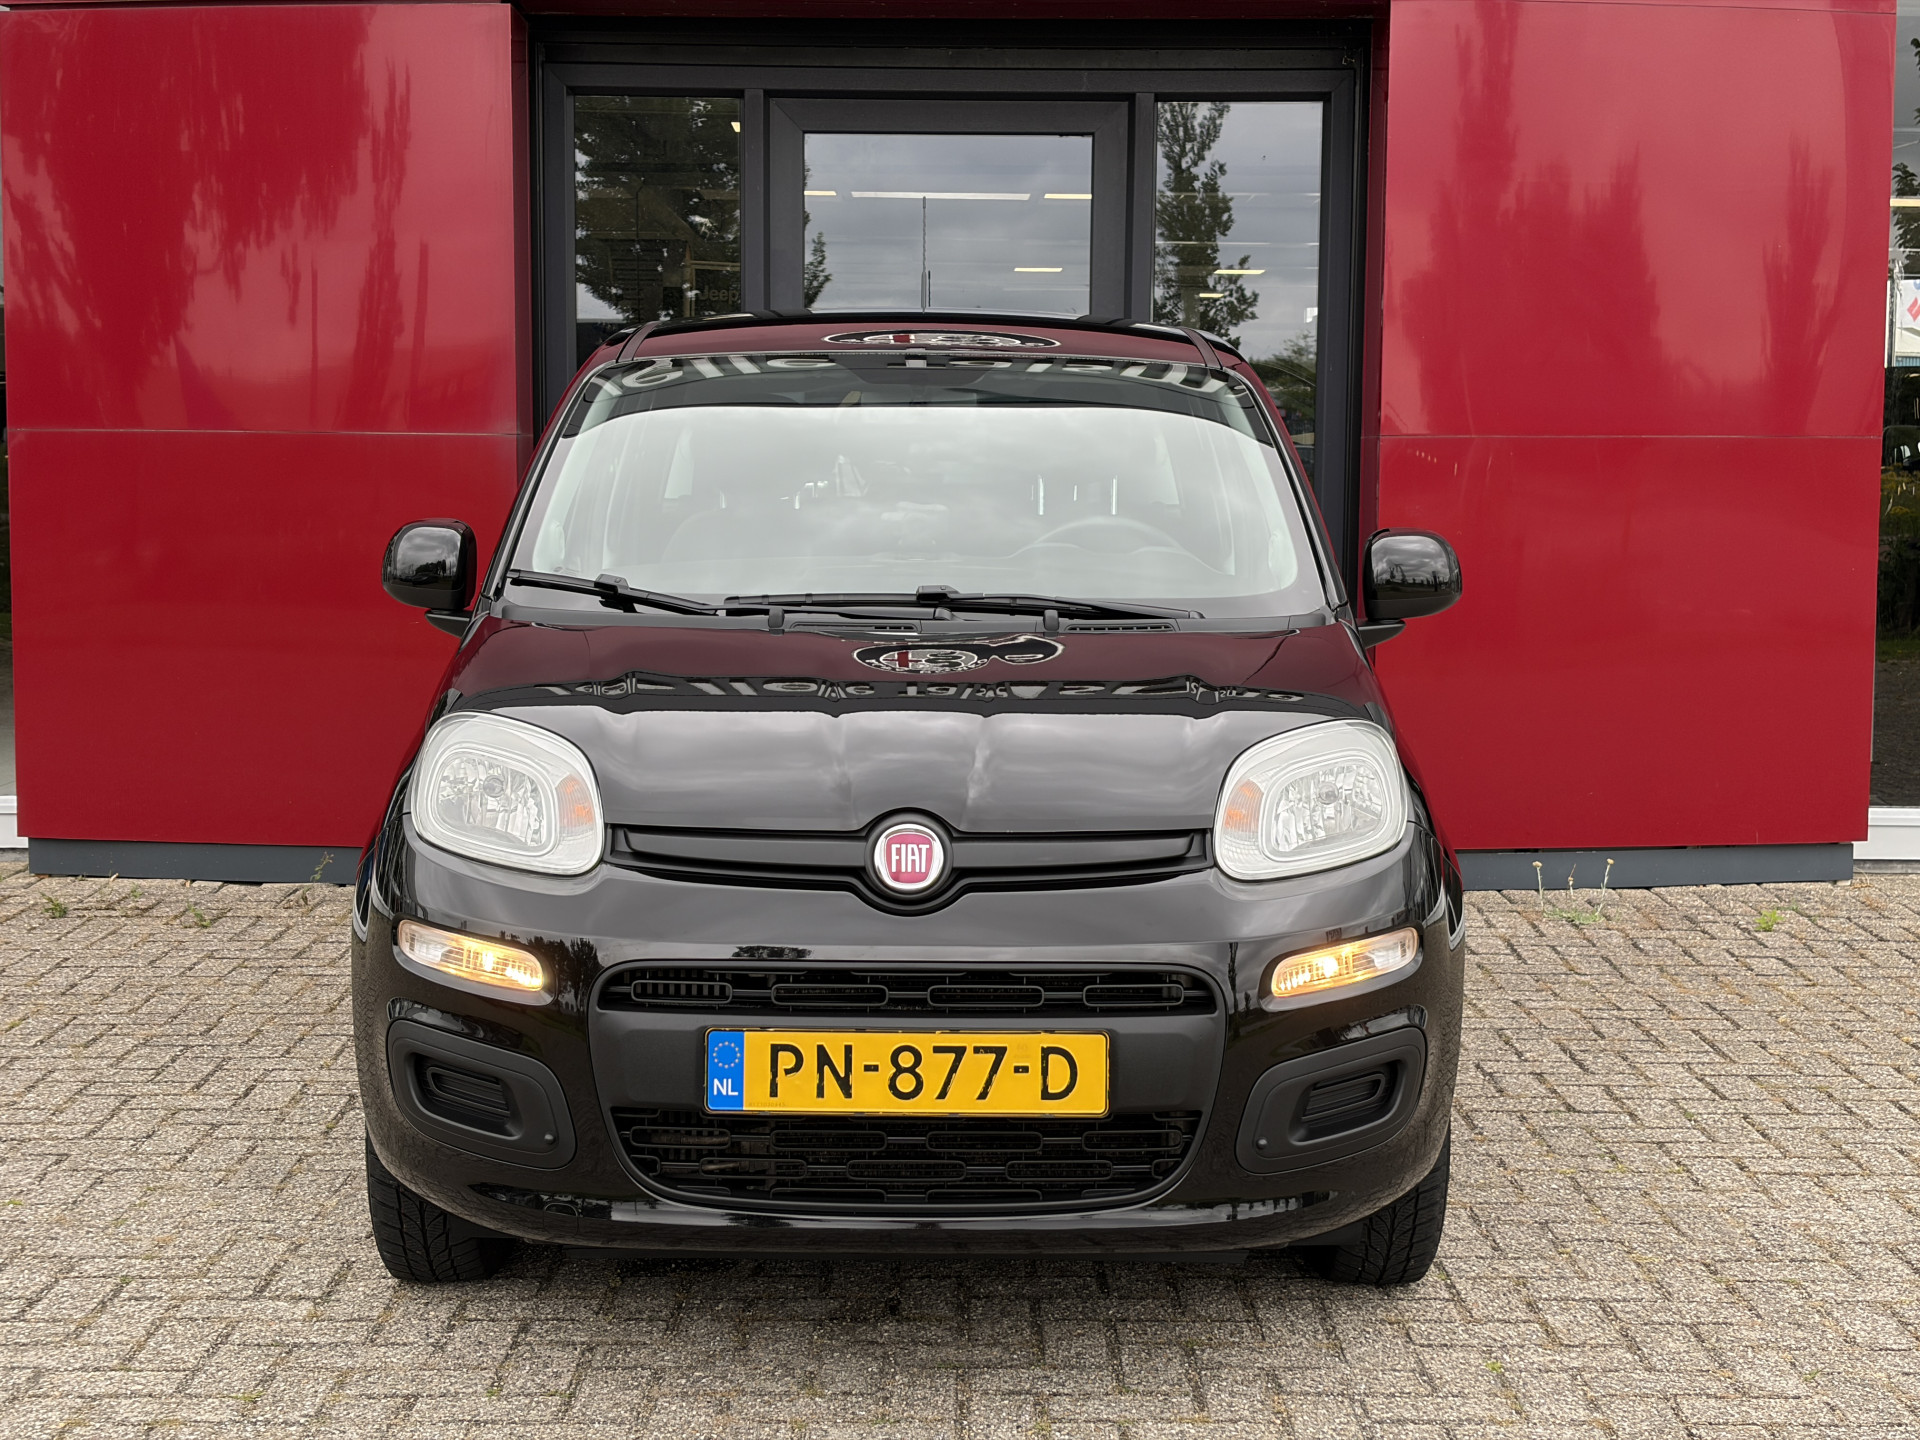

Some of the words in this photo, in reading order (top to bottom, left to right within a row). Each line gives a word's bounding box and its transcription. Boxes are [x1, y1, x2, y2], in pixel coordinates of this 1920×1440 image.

[699, 285, 739, 305] Jeep
[891, 843, 930, 873] FIAT
[769, 1043, 1078, 1101] PN-877-D
[713, 1078, 739, 1096] NL
